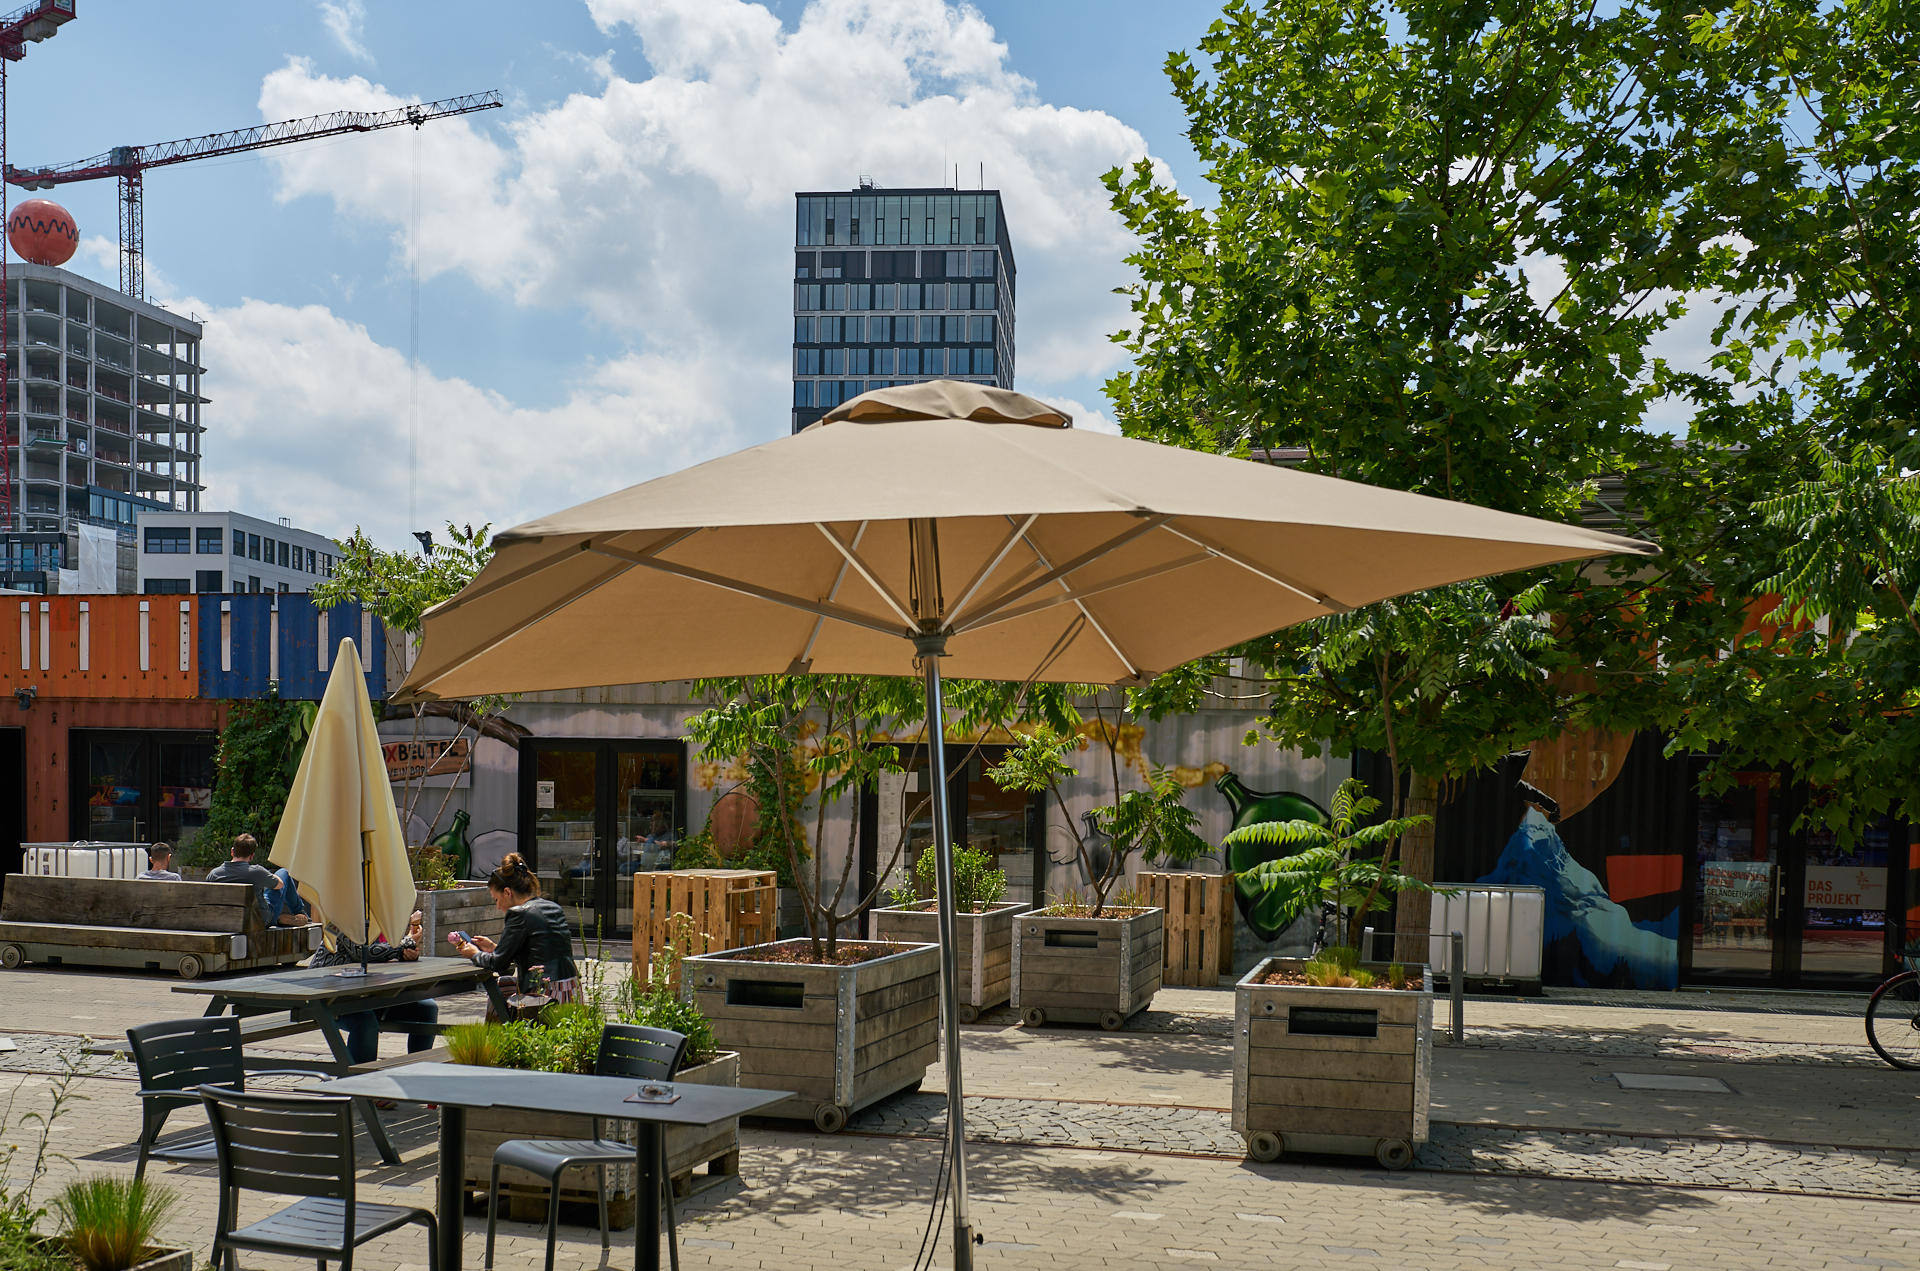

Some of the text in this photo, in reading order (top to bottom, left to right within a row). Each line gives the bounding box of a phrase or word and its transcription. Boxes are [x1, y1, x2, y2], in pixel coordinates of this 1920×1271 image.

[1706, 877, 1735, 889] MITTE
[1808, 880, 1833, 891] DAS
[1706, 888, 1768, 900] GELÄNDEFÜHRUNG
[1808, 893, 1861, 905] PROJEKT
